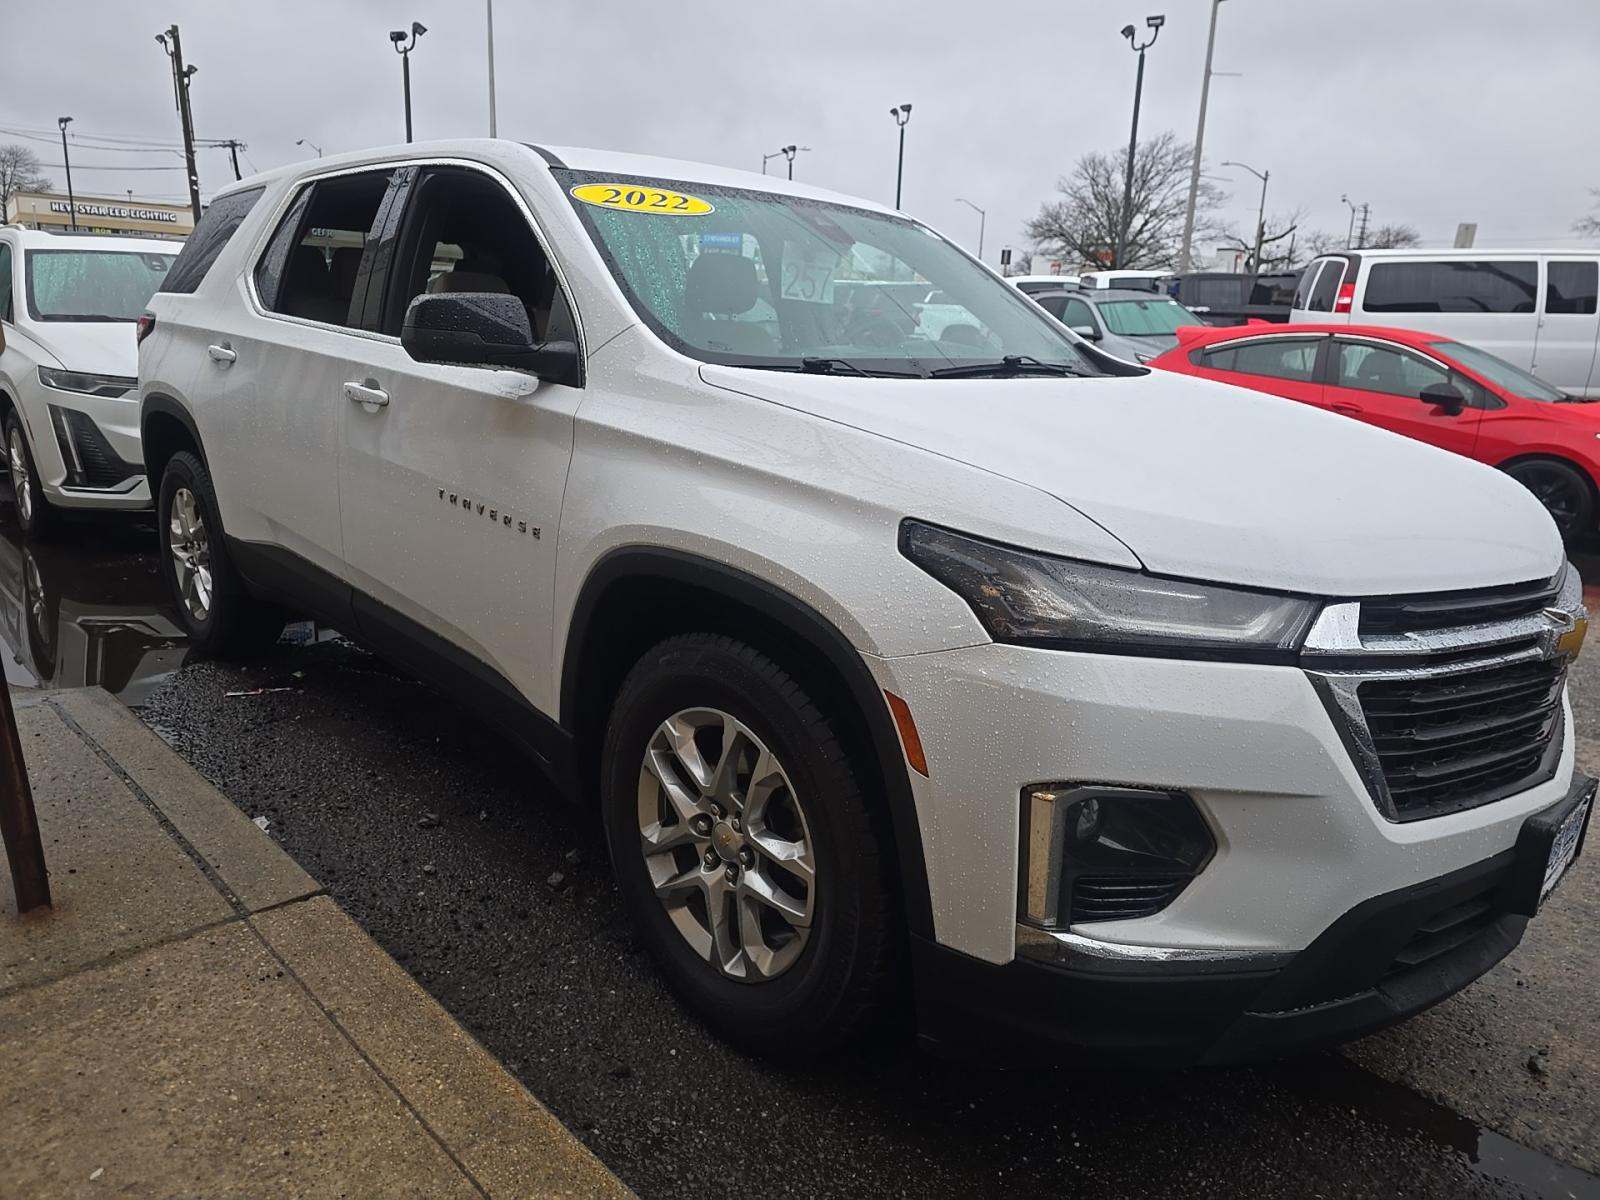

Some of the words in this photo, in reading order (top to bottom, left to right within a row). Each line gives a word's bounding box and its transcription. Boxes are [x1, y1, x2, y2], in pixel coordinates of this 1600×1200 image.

[79, 204, 109, 216] STAR
[109, 207, 127, 218] LED
[129, 209, 176, 222] LIGHTING
[602, 188, 689, 210] 2022
[784, 261, 832, 300] 257
[438, 486, 541, 540] TRAVERSE
